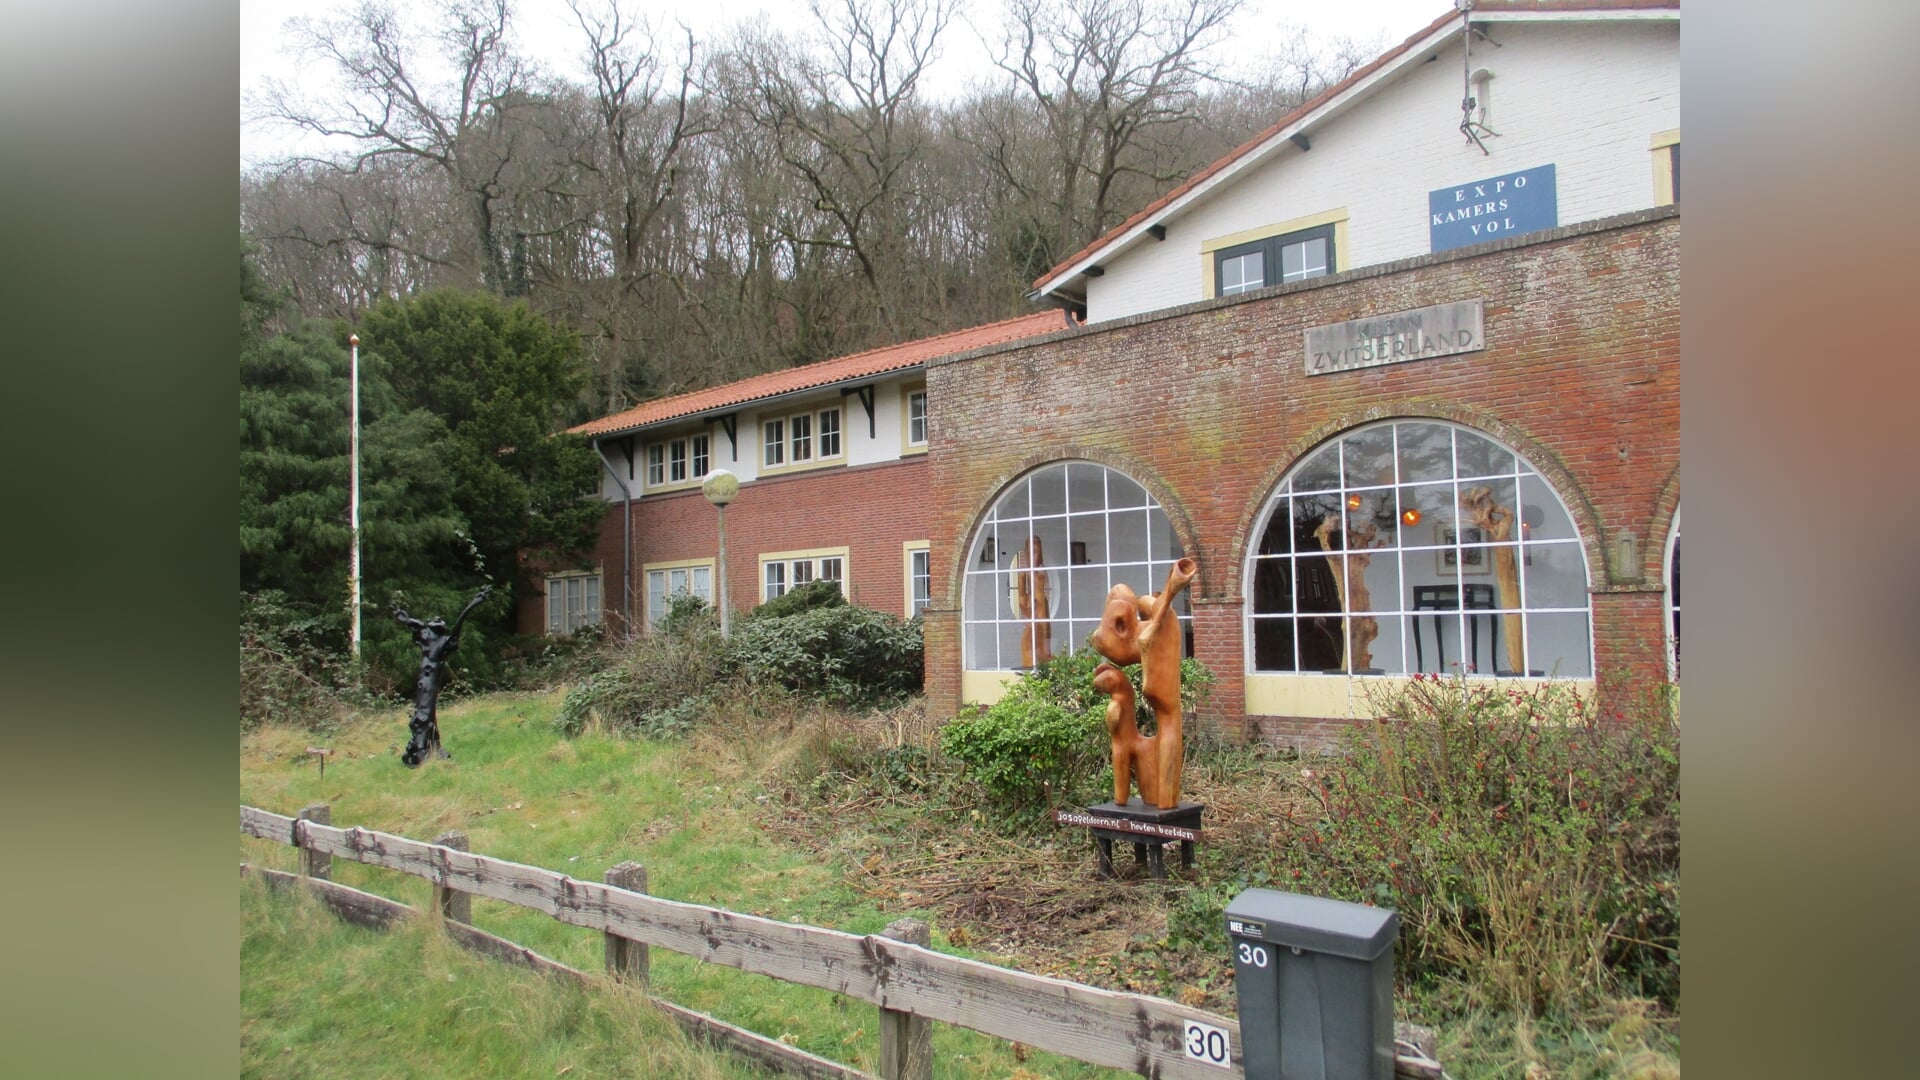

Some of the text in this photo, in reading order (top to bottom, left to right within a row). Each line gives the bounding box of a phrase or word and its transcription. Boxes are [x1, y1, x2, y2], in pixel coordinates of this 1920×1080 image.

[1455, 176, 1527, 202] EXPO
[1432, 199, 1508, 226] KAMERS
[1471, 218, 1515, 236] VOL
[1358, 314, 1423, 342] KLEIN
[1313, 330, 1473, 370] ZWITSERLAND
[1130, 822, 1156, 834] houten
[1158, 825, 1194, 840] beelden
[1239, 942, 1268, 968] 30
[1188, 1025, 1225, 1062] 30
